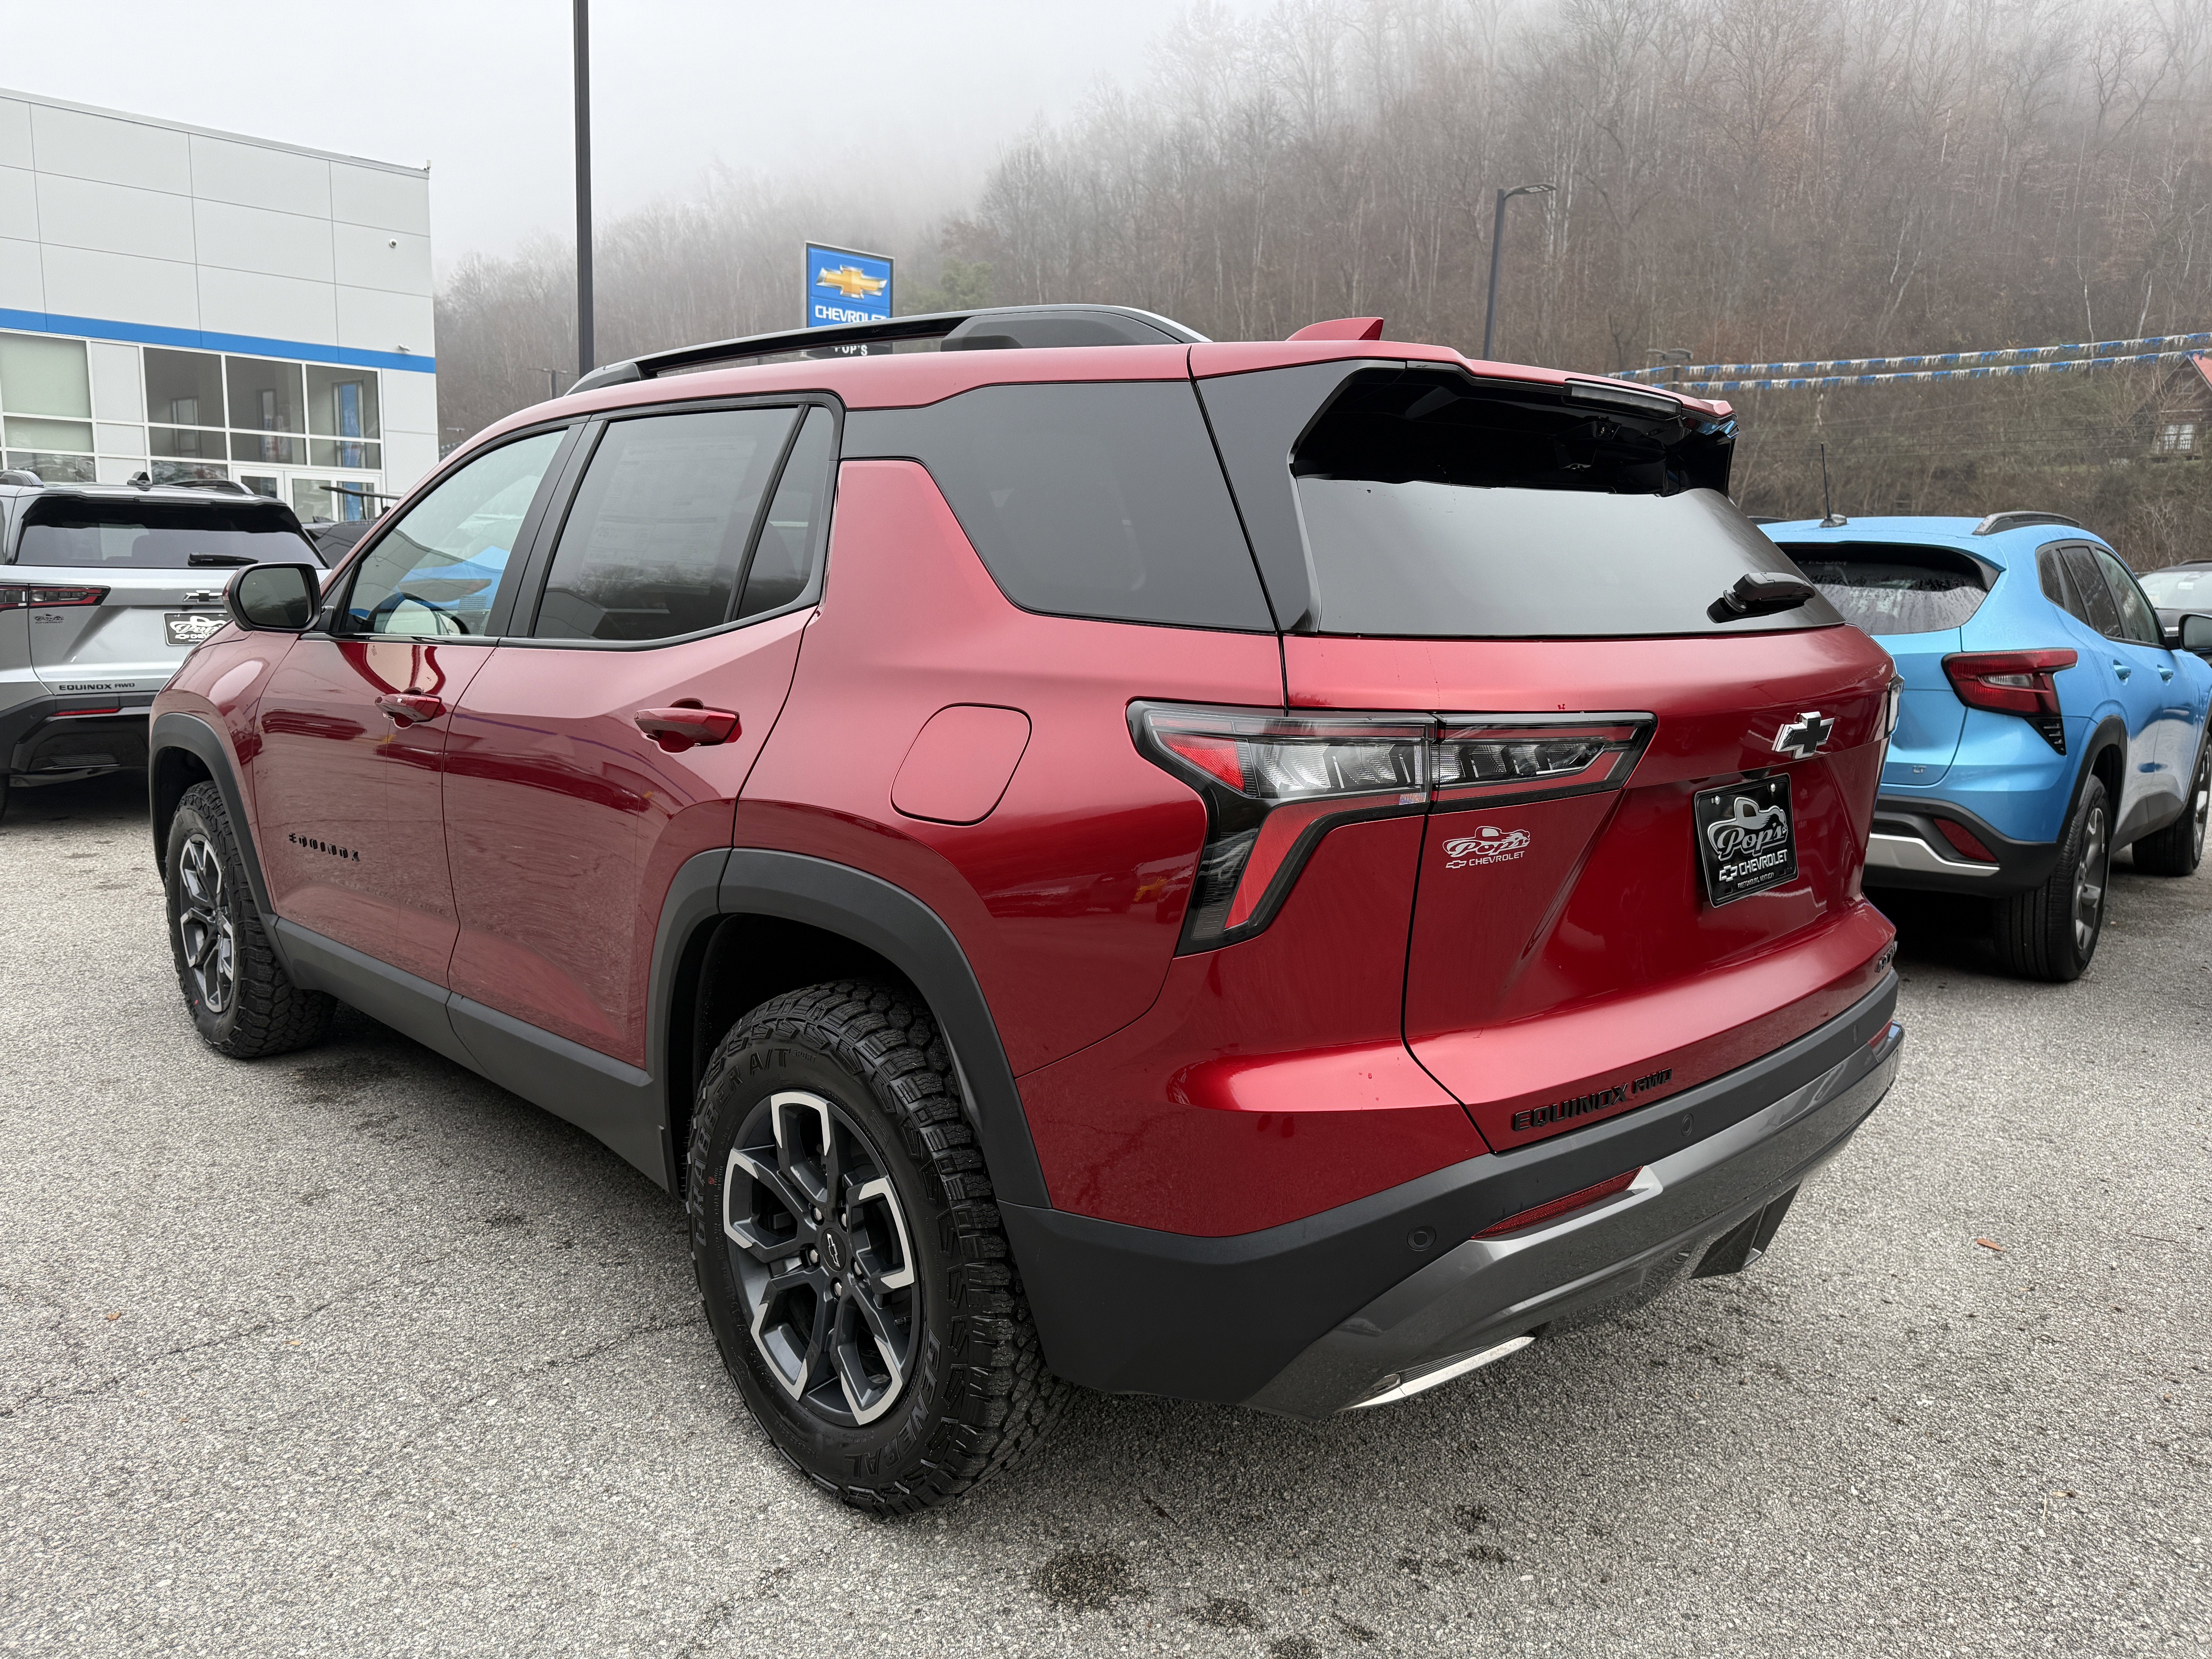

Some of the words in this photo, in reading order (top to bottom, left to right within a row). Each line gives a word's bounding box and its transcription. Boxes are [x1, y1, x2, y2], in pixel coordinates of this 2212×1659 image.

[815, 305, 887, 323] CHEVROL
[1913, 765, 1927, 773] LT
[1717, 823, 1785, 854] Pop's
[1469, 851, 1525, 866] CHEVROLET
[1739, 849, 1788, 876] CHEVROLET
[1512, 1083, 1628, 1132] EQUINOX
[1632, 1067, 1672, 1094] AWD
[843, 1328, 942, 1479] GENERAL
